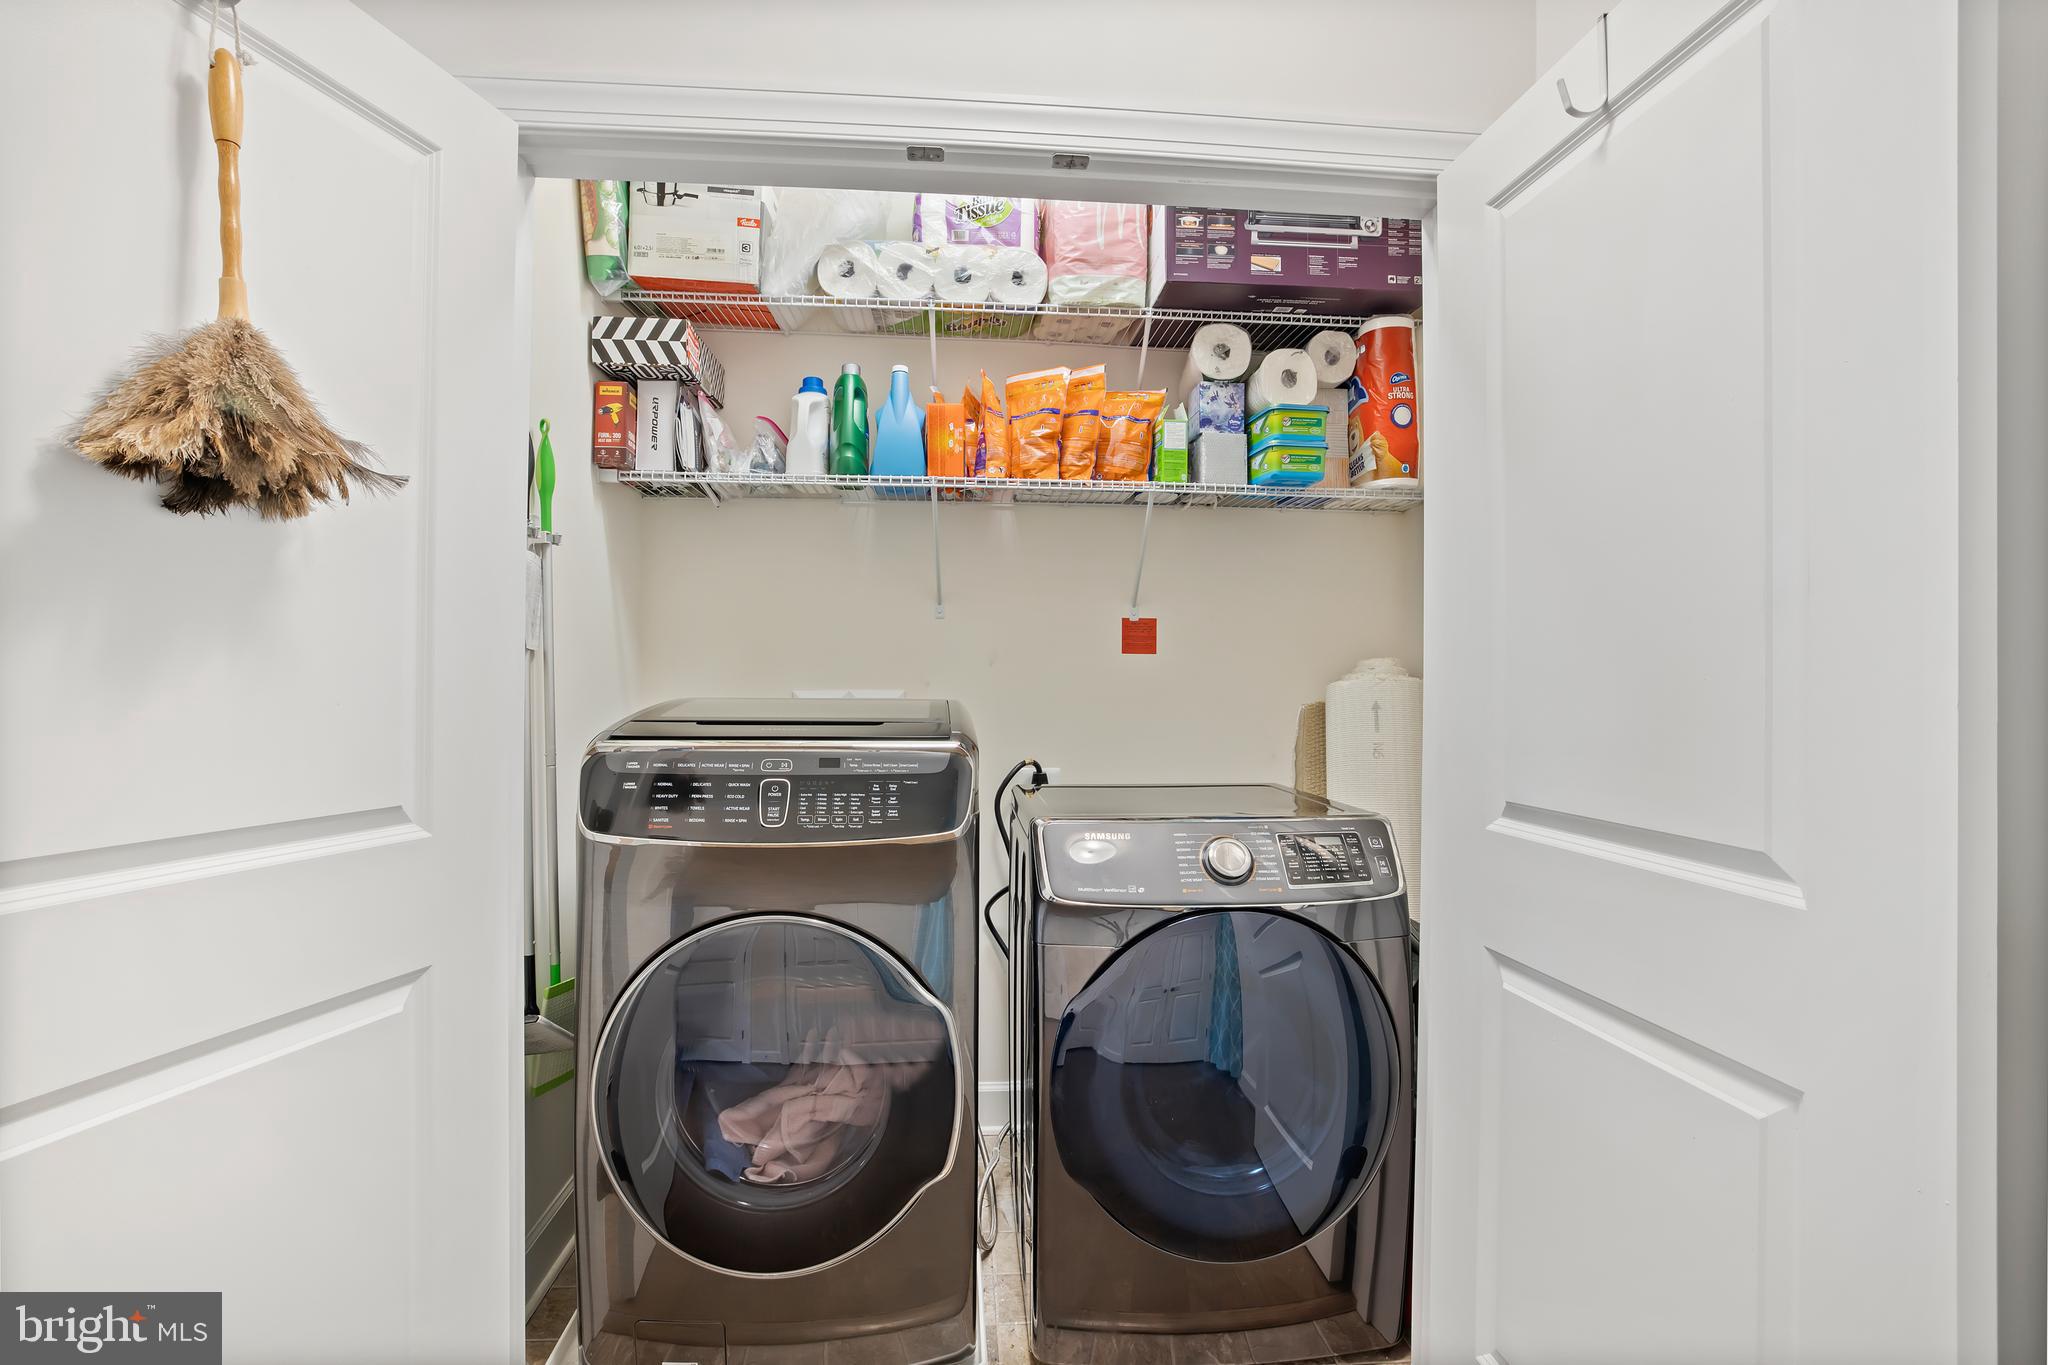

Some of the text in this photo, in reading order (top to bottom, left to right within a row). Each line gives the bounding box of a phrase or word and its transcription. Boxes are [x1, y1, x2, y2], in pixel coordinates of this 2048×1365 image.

[954, 199, 1005, 221] Tissue
[1388, 391, 1413, 400] STRONG
[651, 397, 659, 451] URPOWER
